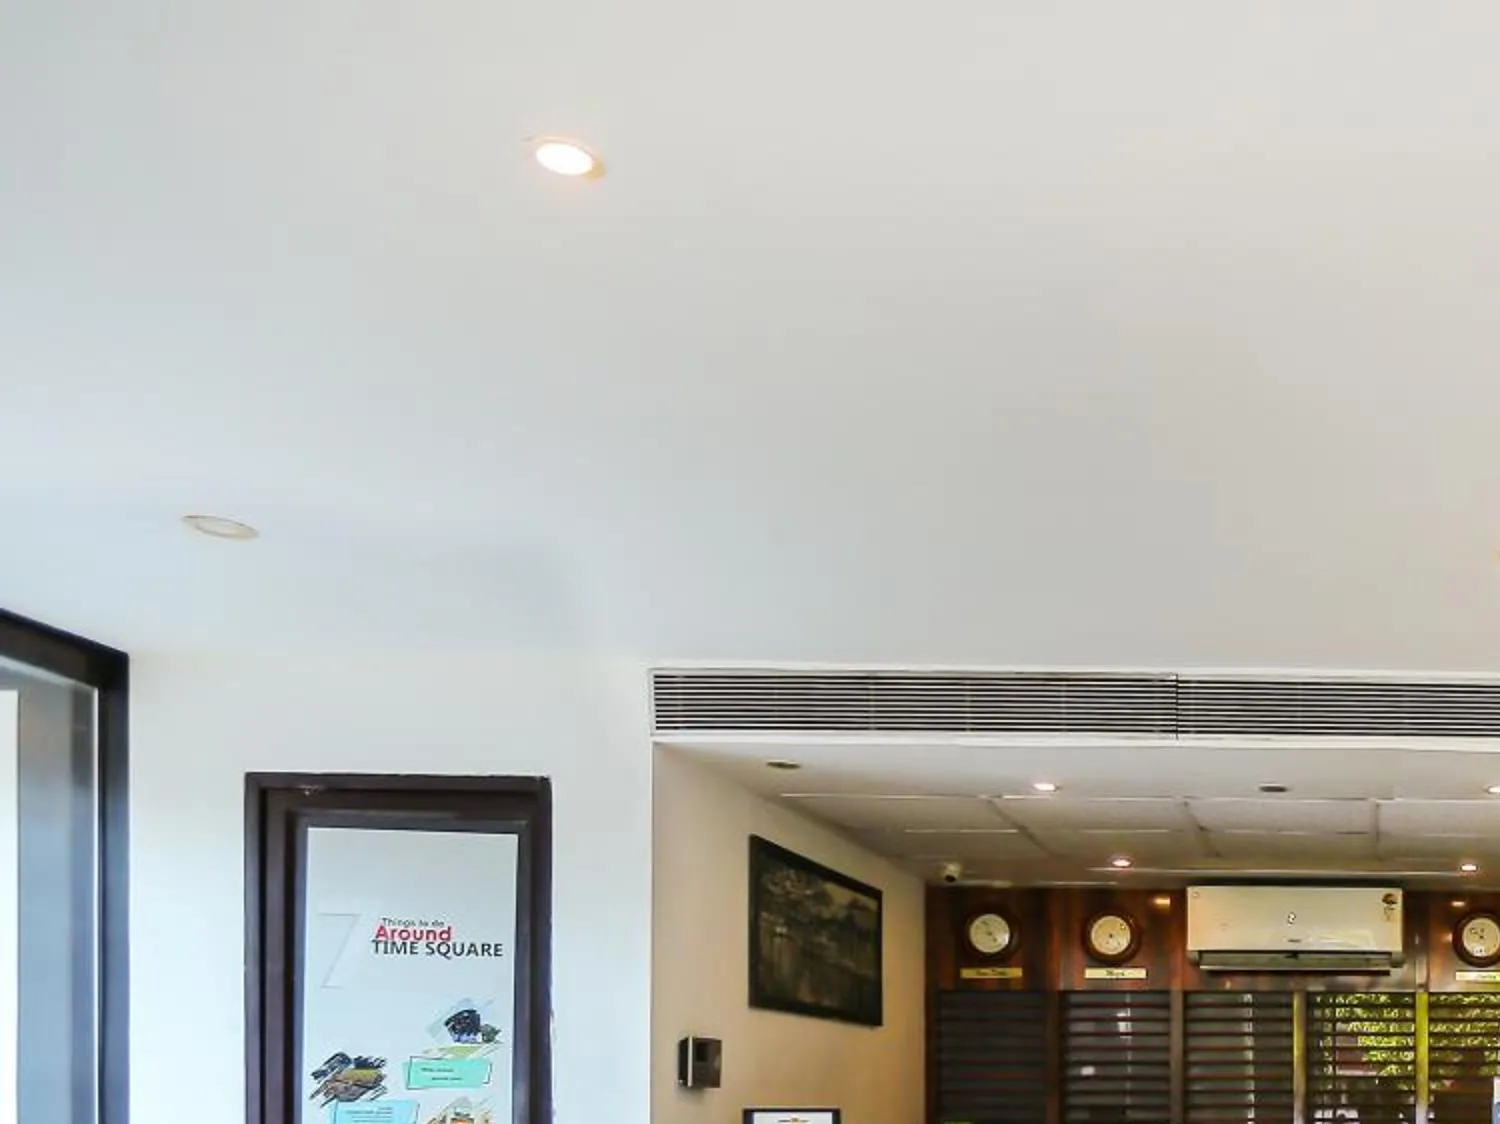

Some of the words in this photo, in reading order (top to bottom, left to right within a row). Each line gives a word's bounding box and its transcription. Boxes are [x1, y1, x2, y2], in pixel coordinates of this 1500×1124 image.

[382, 917, 416, 928] Things
[375, 925, 452, 941] Around
[371, 940, 419, 955] TIME
[425, 941, 503, 960] SQUARE
